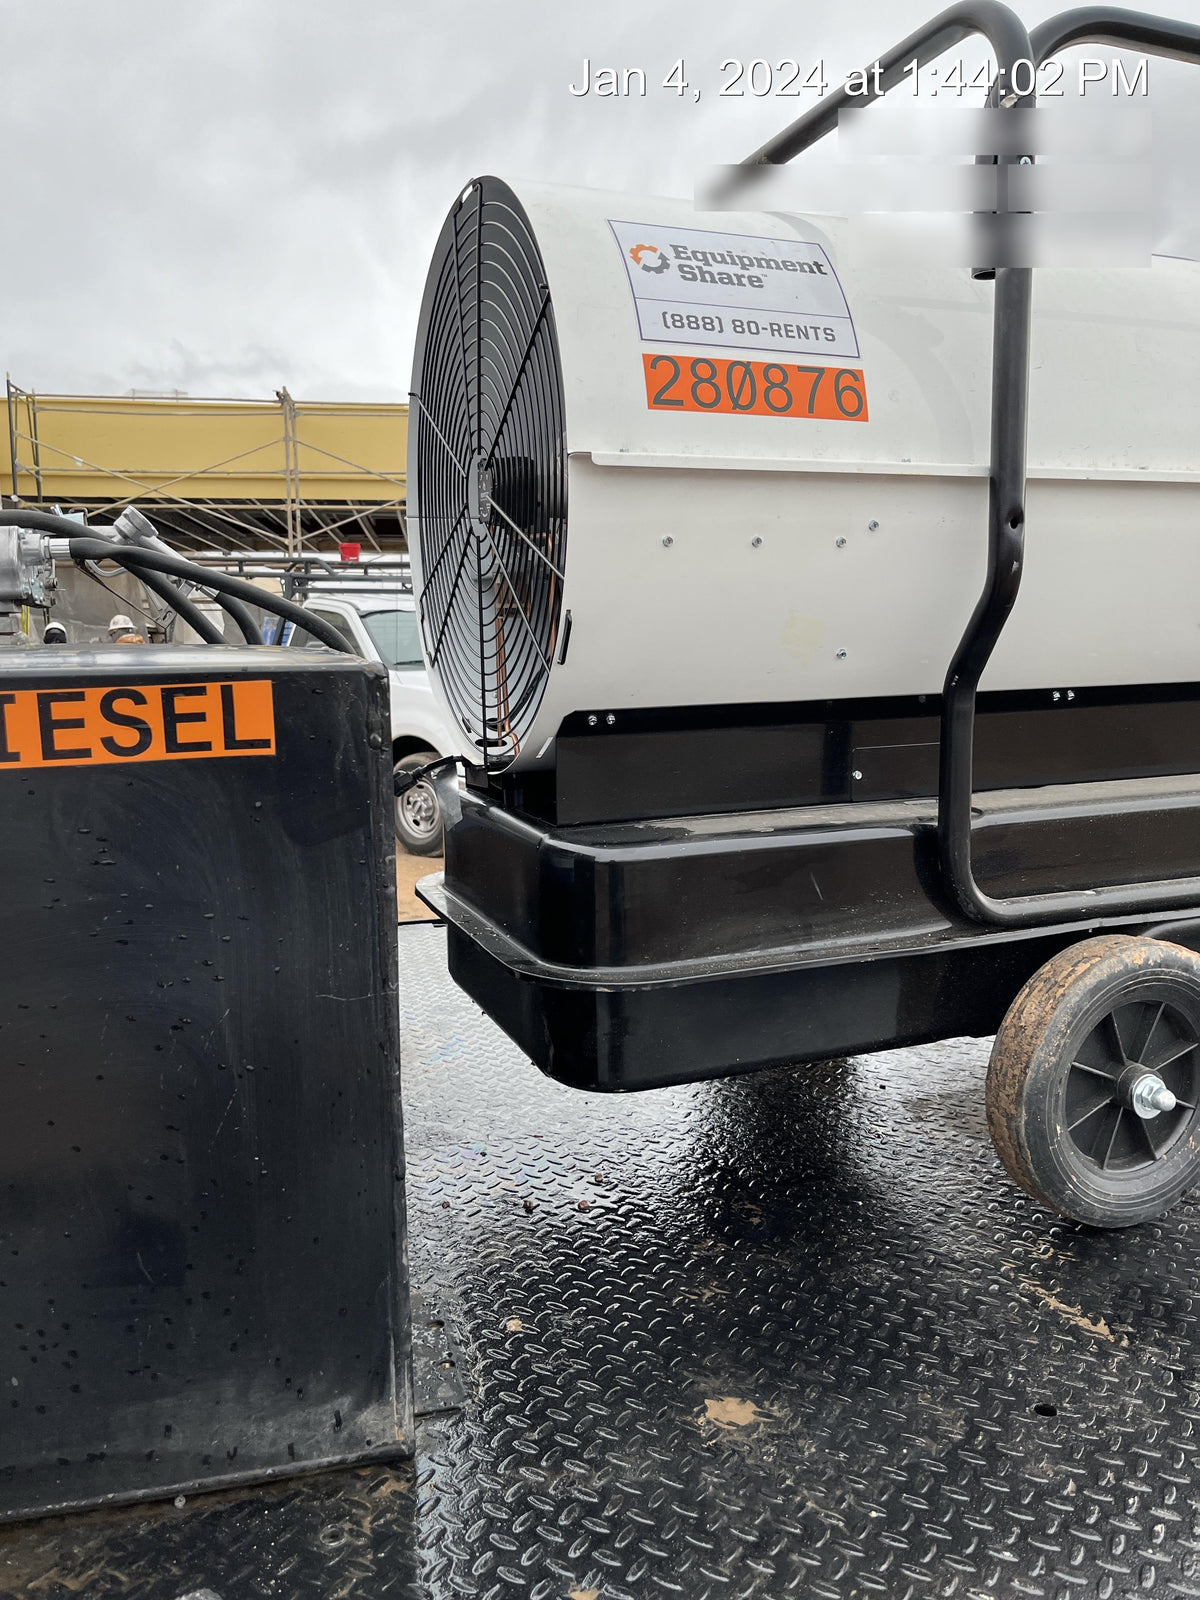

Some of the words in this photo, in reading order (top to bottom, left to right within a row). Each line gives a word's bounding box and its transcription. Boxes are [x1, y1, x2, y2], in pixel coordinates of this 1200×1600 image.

[669, 243, 828, 276] Equipment
[661, 311, 725, 334] (888)
[731, 318, 836, 343] 80-RENTS
